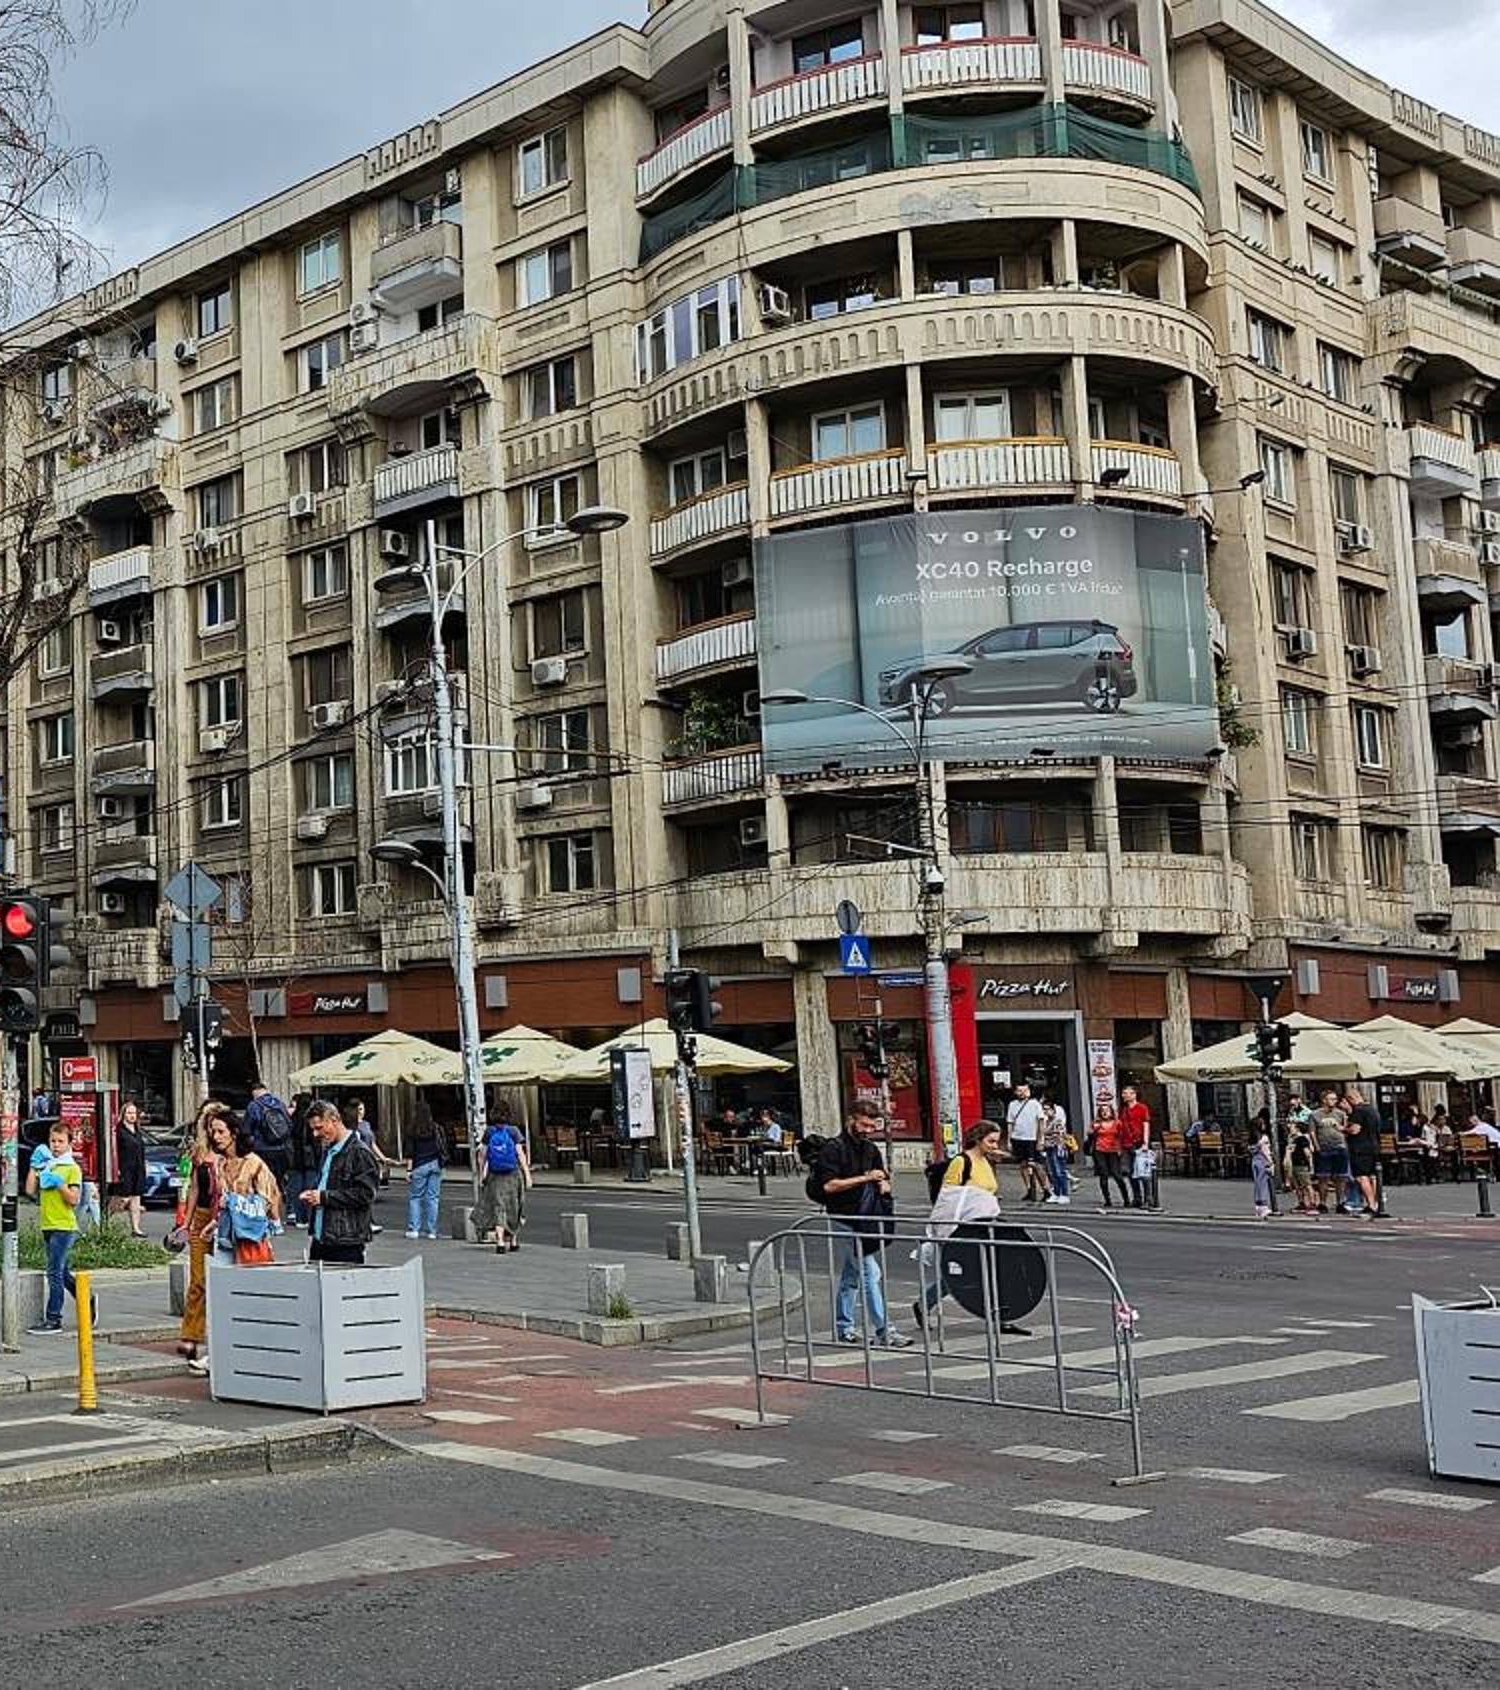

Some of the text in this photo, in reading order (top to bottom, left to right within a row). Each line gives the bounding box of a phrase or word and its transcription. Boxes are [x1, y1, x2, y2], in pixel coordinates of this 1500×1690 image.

[927, 526, 1077, 544] VOLVO
[916, 557, 1093, 580] XC40 Recharge
[980, 979, 1069, 998] Pizza Hut
